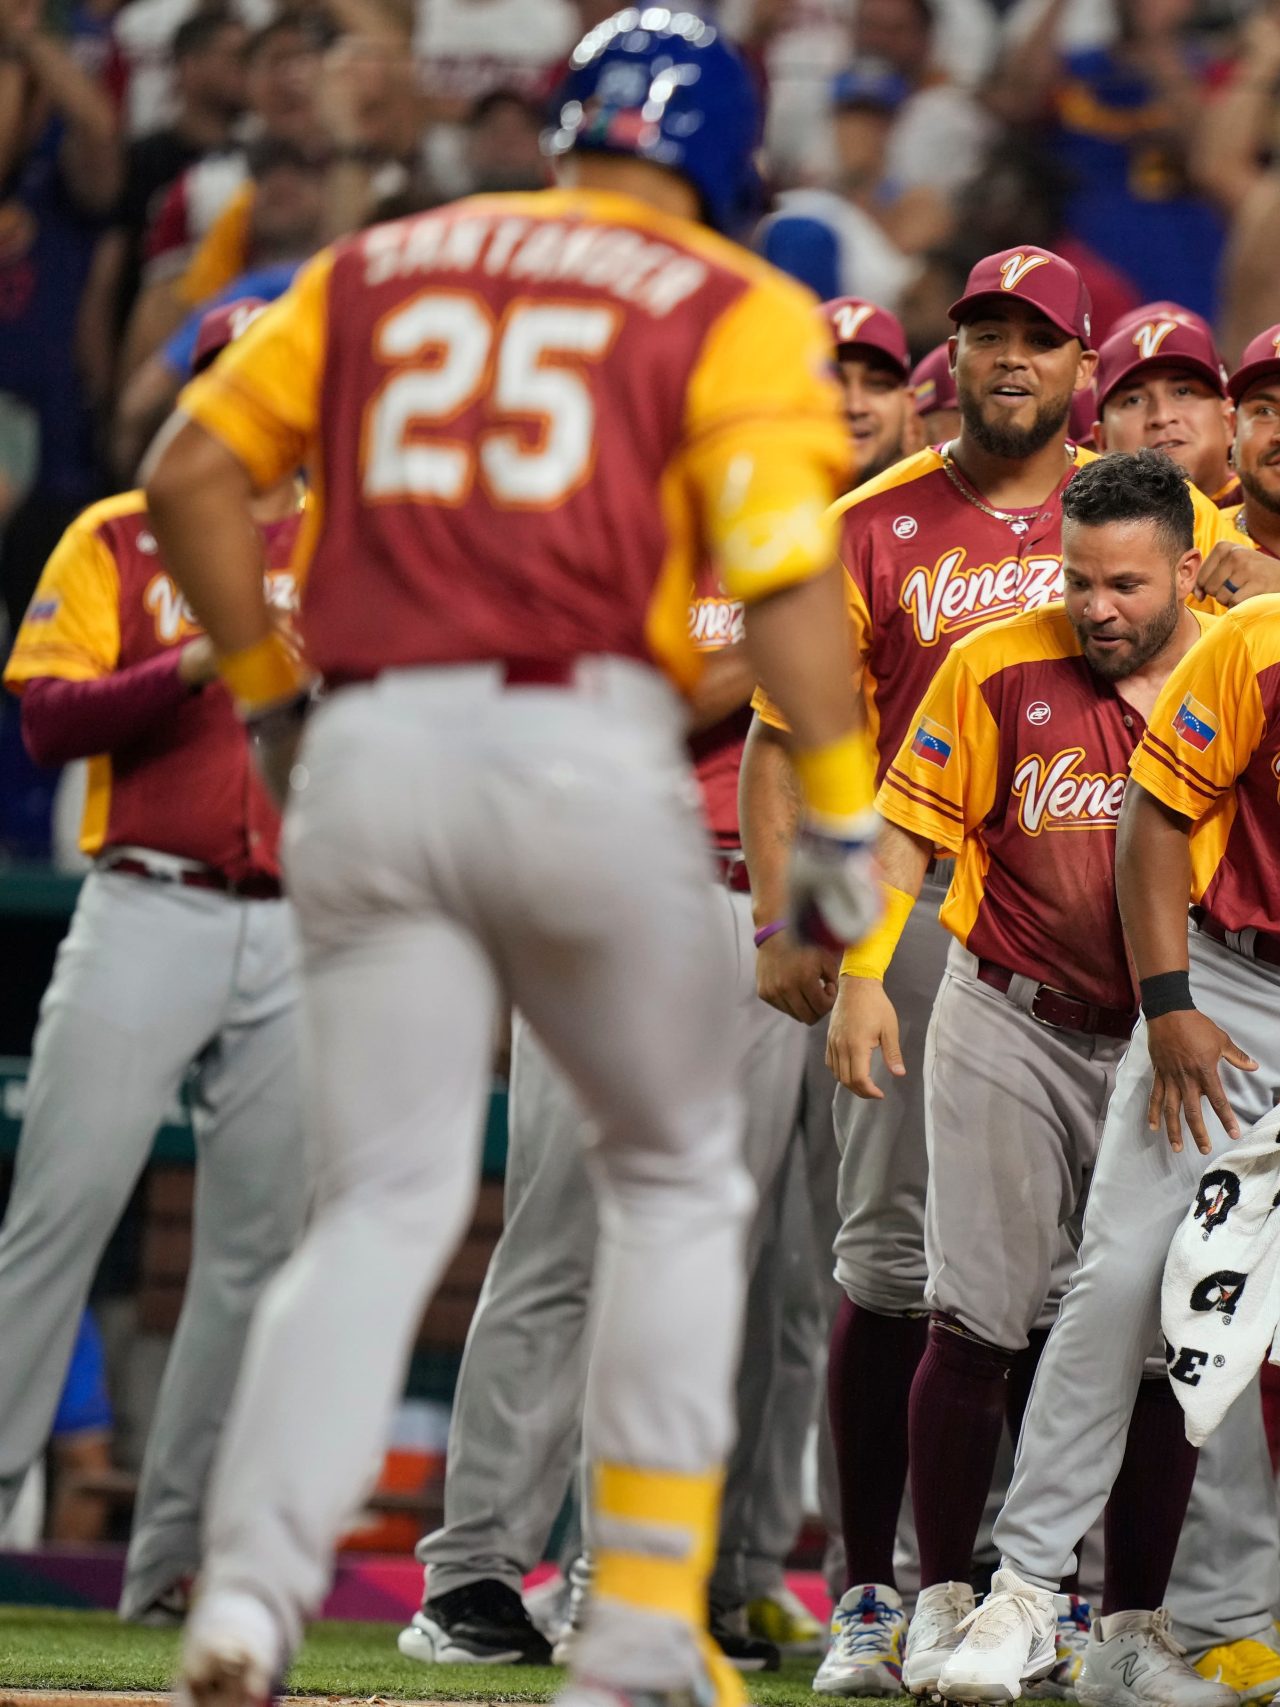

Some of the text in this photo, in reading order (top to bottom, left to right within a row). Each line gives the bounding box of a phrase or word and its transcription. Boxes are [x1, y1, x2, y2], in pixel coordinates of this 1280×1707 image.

[1000, 253, 1049, 291] V
[832, 304, 875, 339] V
[1132, 320, 1177, 359] V
[360, 285, 624, 511] 25
